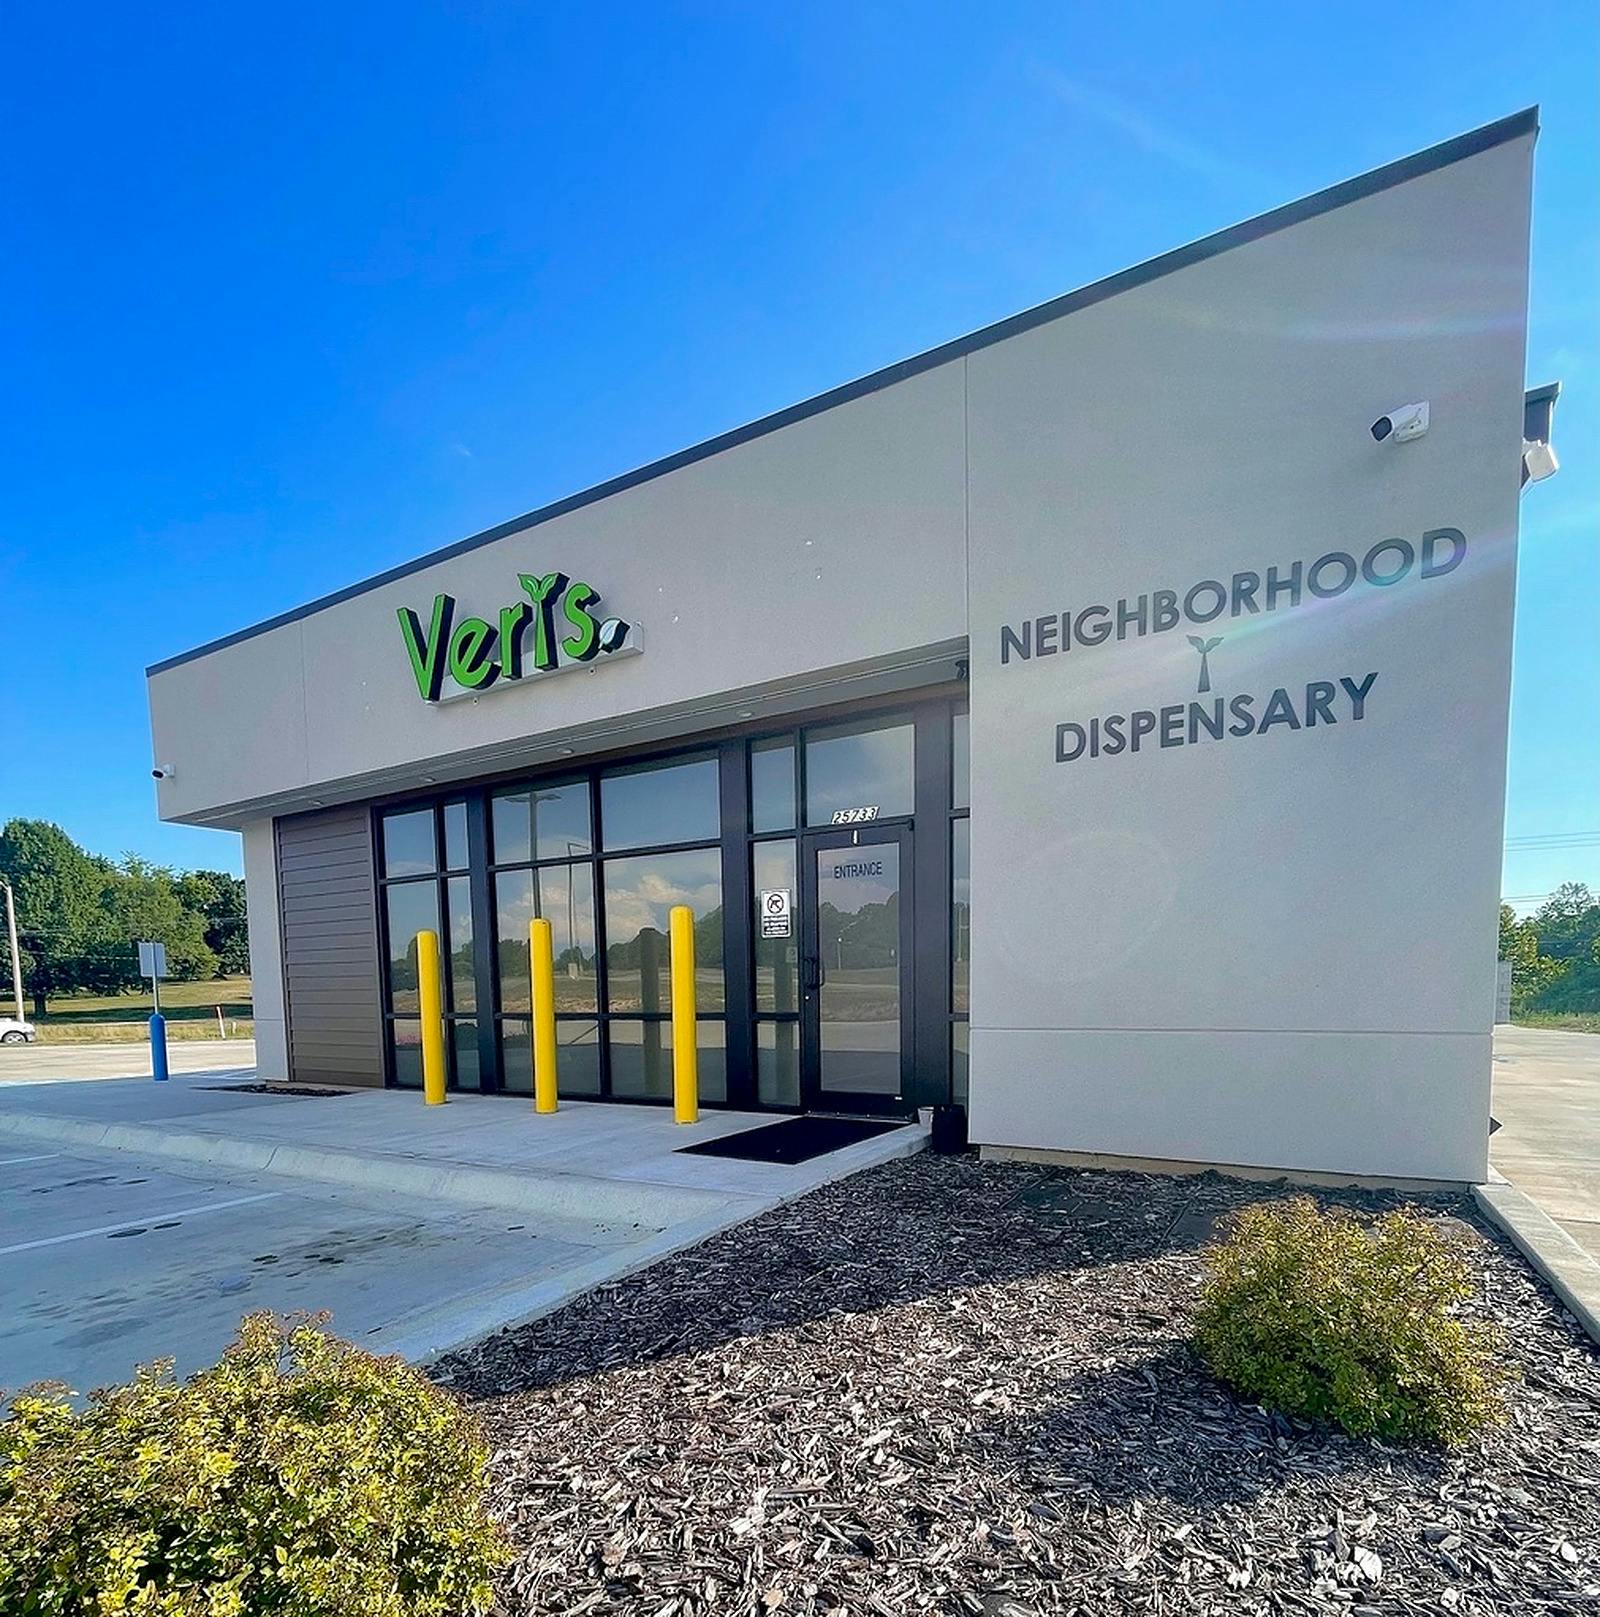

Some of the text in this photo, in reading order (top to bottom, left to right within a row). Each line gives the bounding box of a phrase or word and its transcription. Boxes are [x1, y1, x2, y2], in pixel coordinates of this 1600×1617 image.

[1000, 527, 1467, 665] NEIGHBORHOOD
[1055, 672, 1379, 763] DISPENSARY
[831, 806, 880, 825] 25733
[833, 861, 883, 879] ENTRANCE
